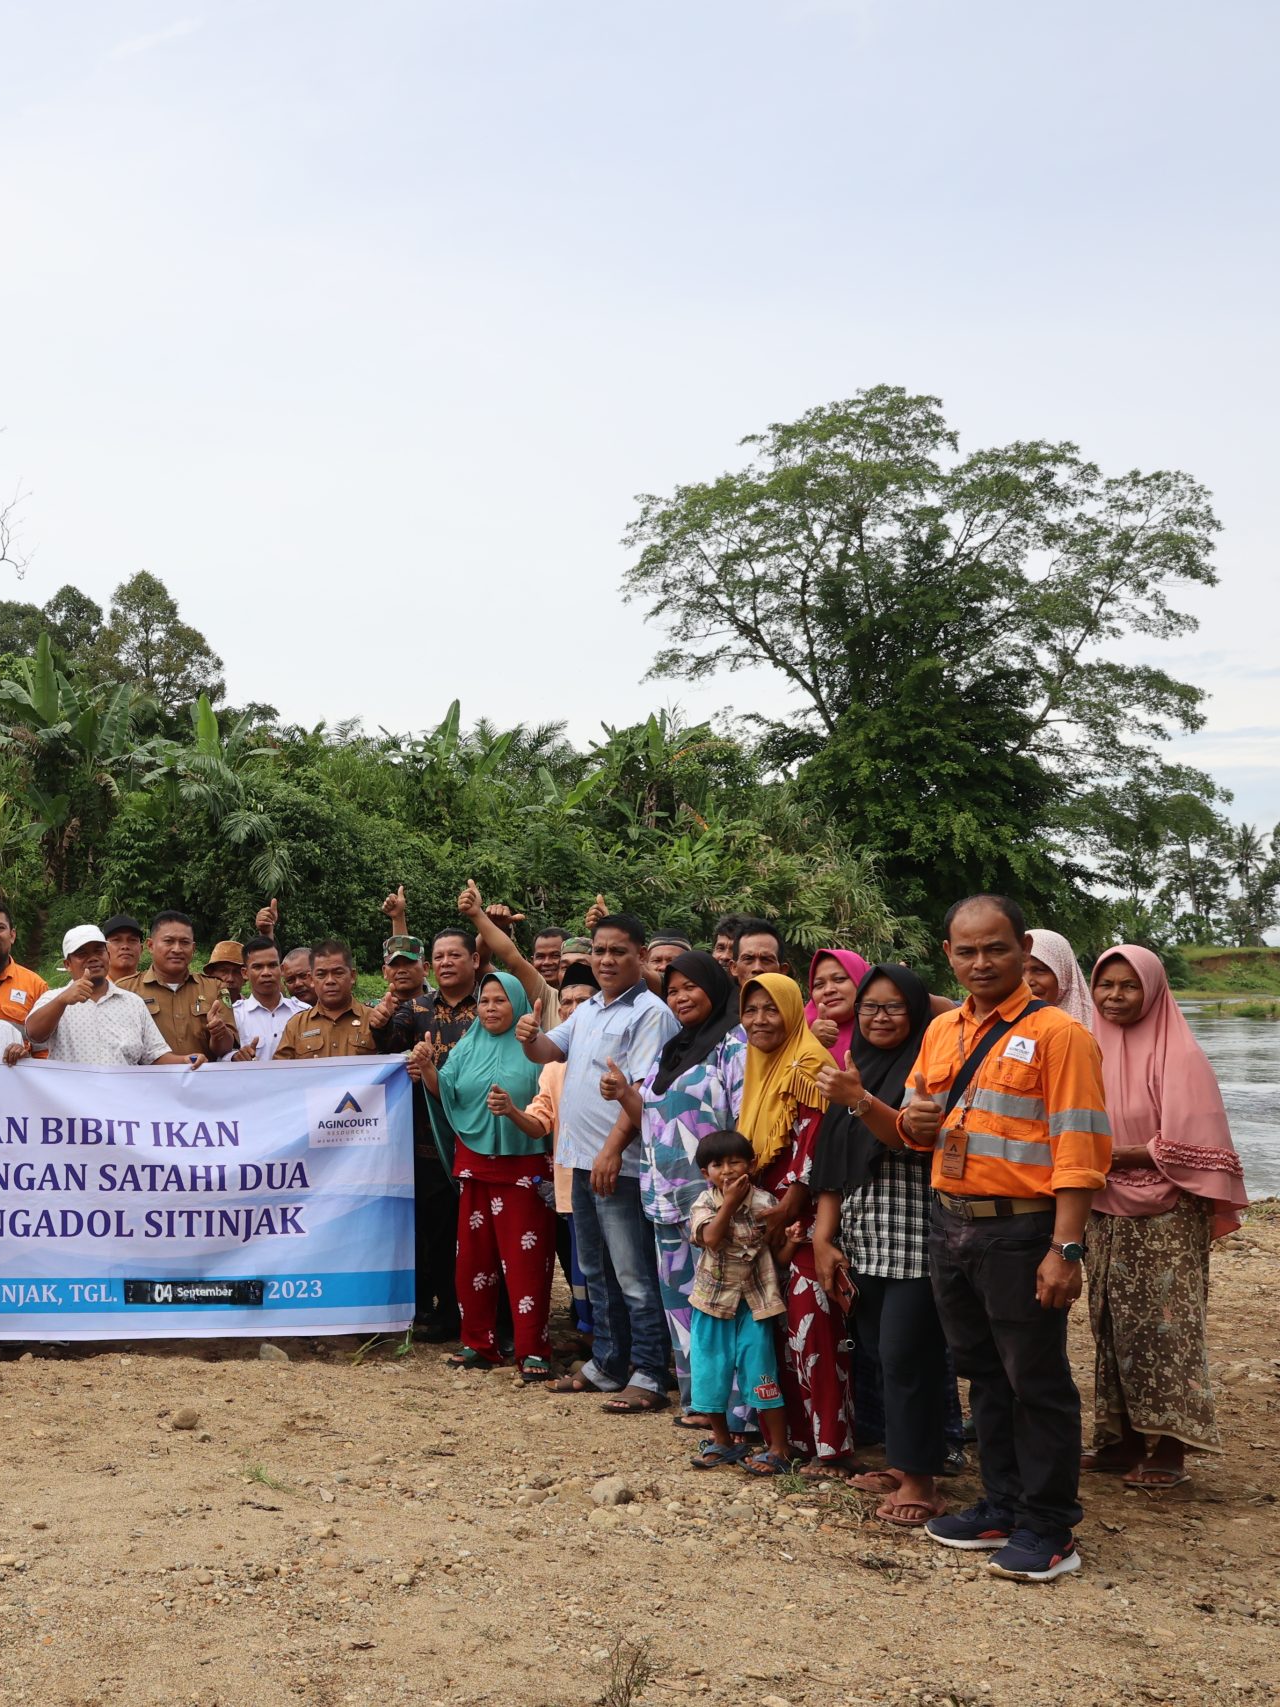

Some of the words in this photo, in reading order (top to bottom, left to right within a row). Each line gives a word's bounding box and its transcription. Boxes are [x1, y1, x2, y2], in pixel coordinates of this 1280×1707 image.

[40, 1117, 140, 1146] BIBIT
[150, 1120, 240, 1147] IKAN
[318, 1118, 379, 1129] AGINCOURT
[98, 1163, 228, 1192] SATAHI
[238, 1161, 310, 1190] DUA
[144, 1206, 306, 1242] SITINJAK
[69, 1284, 118, 1303] TGL.
[154, 1284, 173, 1303] 04
[177, 1287, 233, 1300] September
[268, 1280, 323, 1299] 2023
